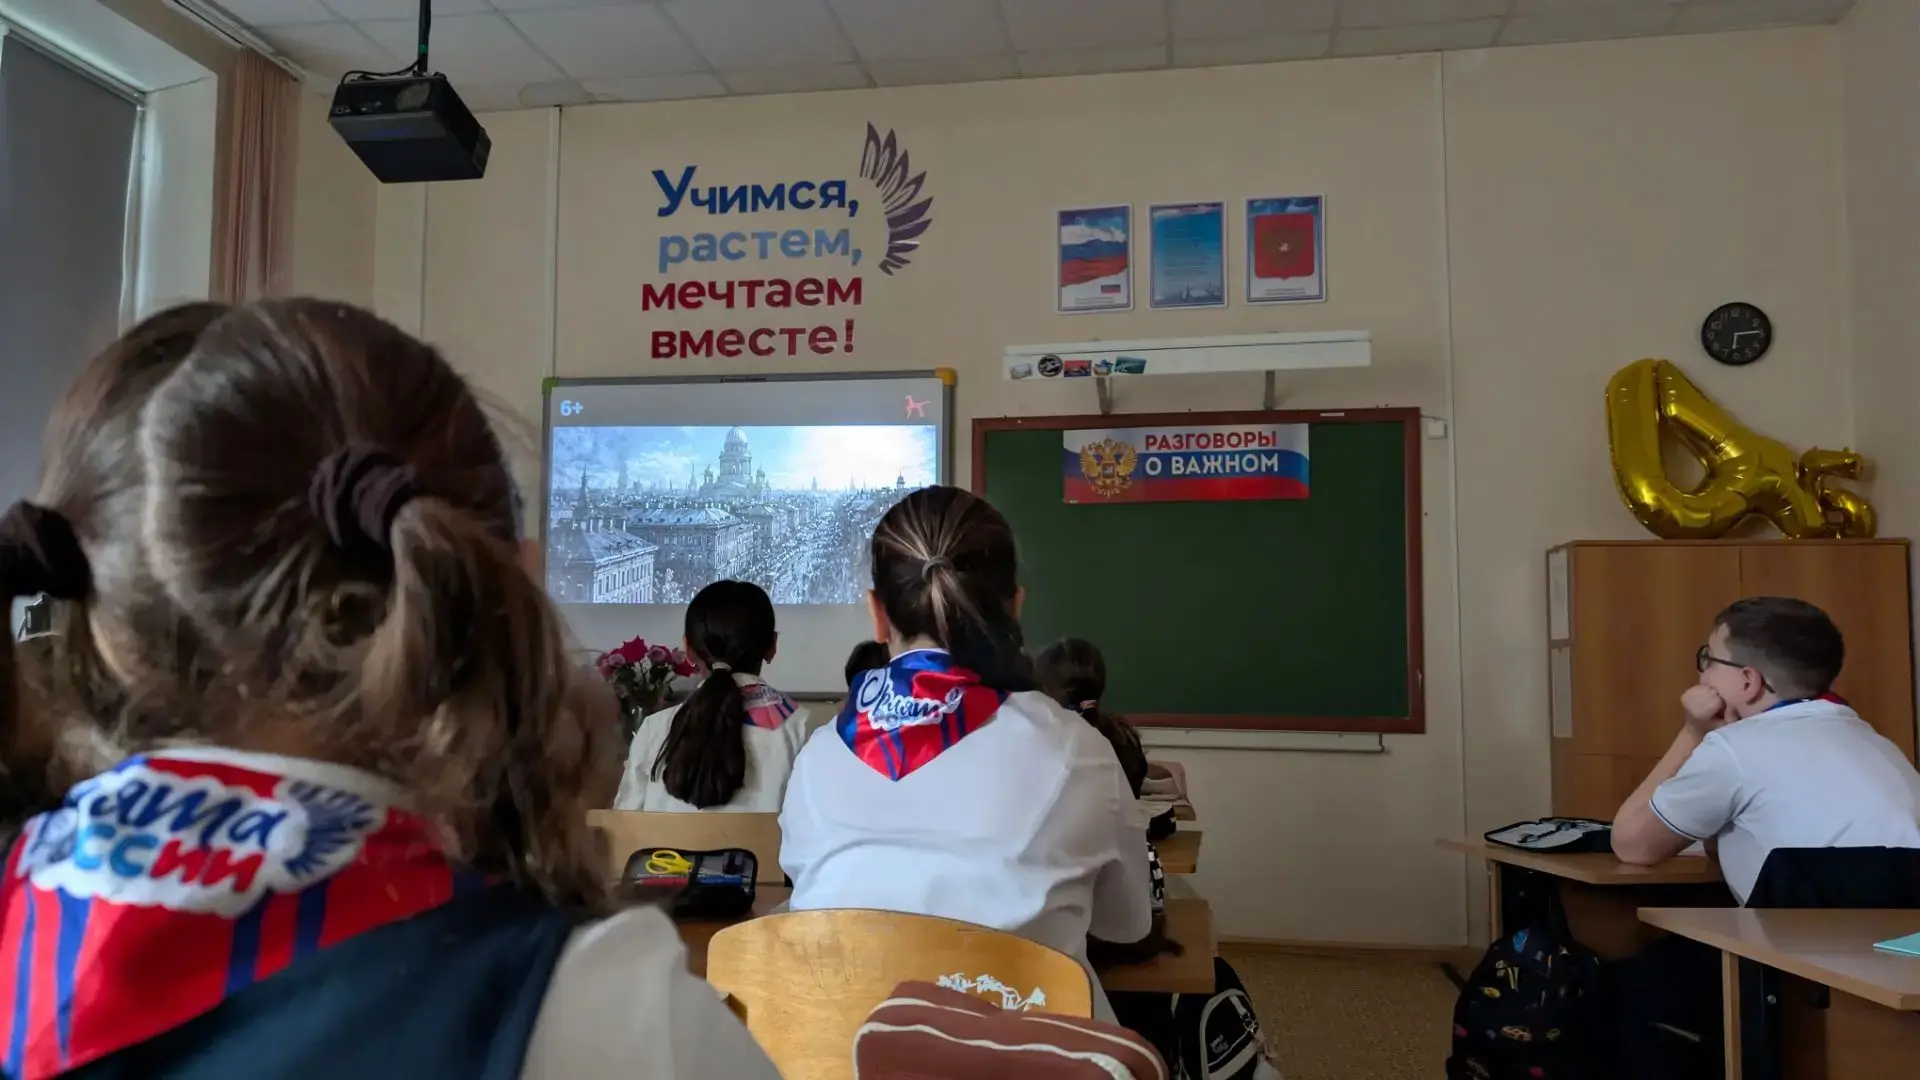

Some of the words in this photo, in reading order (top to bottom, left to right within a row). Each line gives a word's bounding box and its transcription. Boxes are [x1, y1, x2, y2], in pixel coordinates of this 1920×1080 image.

[651, 165, 859, 218] Учимся,
[658, 228, 863, 273] растем,
[642, 276, 862, 311] мечтаем
[651, 319, 855, 359] вместе!
[560, 399, 584, 417] 6+
[1144, 430, 1278, 451] РАЗГОВОРЫ
[1145, 456, 1162, 476] О
[1171, 453, 1279, 475] ВАЖНОМ
